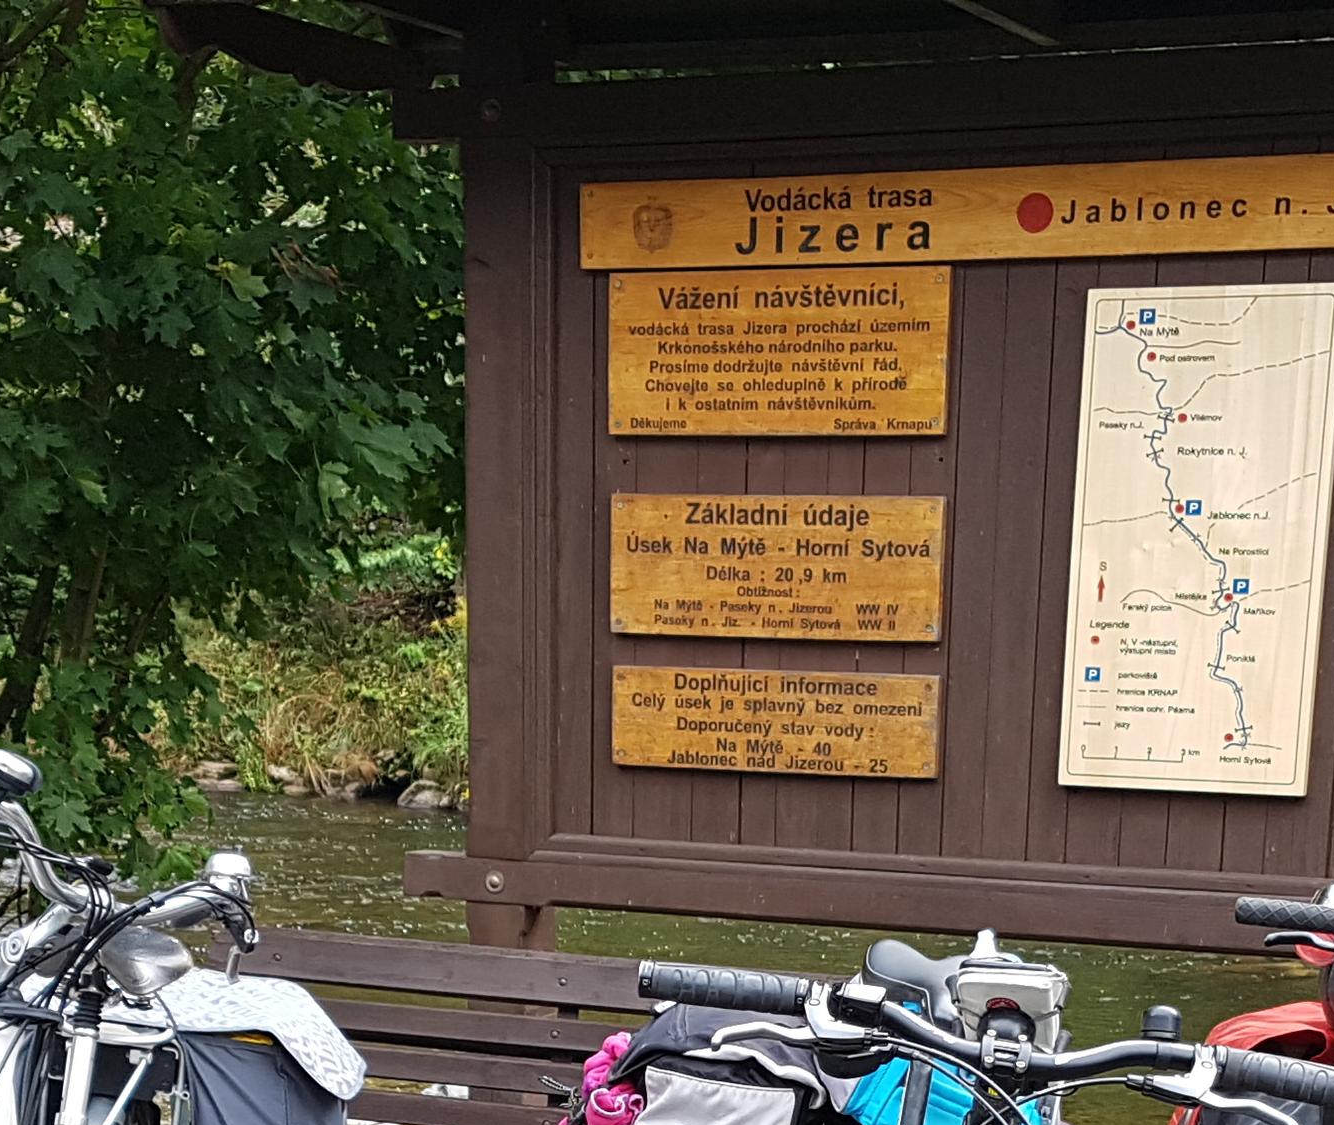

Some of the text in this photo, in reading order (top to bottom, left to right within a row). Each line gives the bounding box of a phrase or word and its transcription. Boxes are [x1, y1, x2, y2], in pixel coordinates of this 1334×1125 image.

[744, 186, 933, 212] Vodácká trasa
[1062, 197, 1248, 224] Jablonec
[1274, 195, 1307, 215] n.
[735, 216, 931, 255] Jizera
[659, 282, 905, 310] Vážení návštěvníci,
[629, 318, 930, 337] vodácká trasa Jizera prochází územím
[1139, 327, 1153, 336] Na
[658, 339, 897, 357] Krkonošského národního parku.
[649, 357, 902, 376] Prosíme dodržujte návštěvní řád.
[645, 376, 907, 396] Chovejte se ohleduplně k přírodě
[666, 397, 876, 411] i k ostatním návštěvníkům.
[630, 417, 687, 432] Děkujeme
[834, 416, 876, 432] Správa
[1177, 446, 1224, 458] Rokytnice
[685, 502, 869, 532] Základní údaje
[1207, 511, 1251, 520] Jablonec
[626, 532, 672, 554] Úsek
[684, 537, 708, 555] Na
[721, 537, 766, 560] Mýtě
[796, 538, 849, 557] Horní
[862, 538, 930, 561] Sytová
[706, 565, 750, 582] Délka
[823, 568, 847, 584] km
[654, 599, 670, 610] Na
[676, 600, 702, 614] Mýtě
[720, 600, 761, 615] Paseky
[789, 603, 832, 614] Jizerou
[856, 604, 881, 615] WW
[887, 605, 899, 616] IV
[654, 614, 694, 629] Paseky
[801, 618, 840, 631] Sytová
[858, 620, 881, 630] WW
[889, 620, 895, 630] II
[674, 672, 877, 696] Doplňující informace
[632, 693, 665, 710] Celý
[675, 694, 711, 710] úsek
[721, 696, 734, 714] je
[744, 696, 805, 716] splavný
[815, 700, 843, 715] bez
[676, 717, 772, 738] Doporučený
[781, 721, 814, 736] stav
[717, 738, 736, 753] Na
[746, 740, 784, 759] Mýtě
[813, 742, 831, 757] 40
[667, 749, 737, 767] Jablonec
[786, 754, 844, 772] Jizerou
[869, 759, 888, 774] 25
